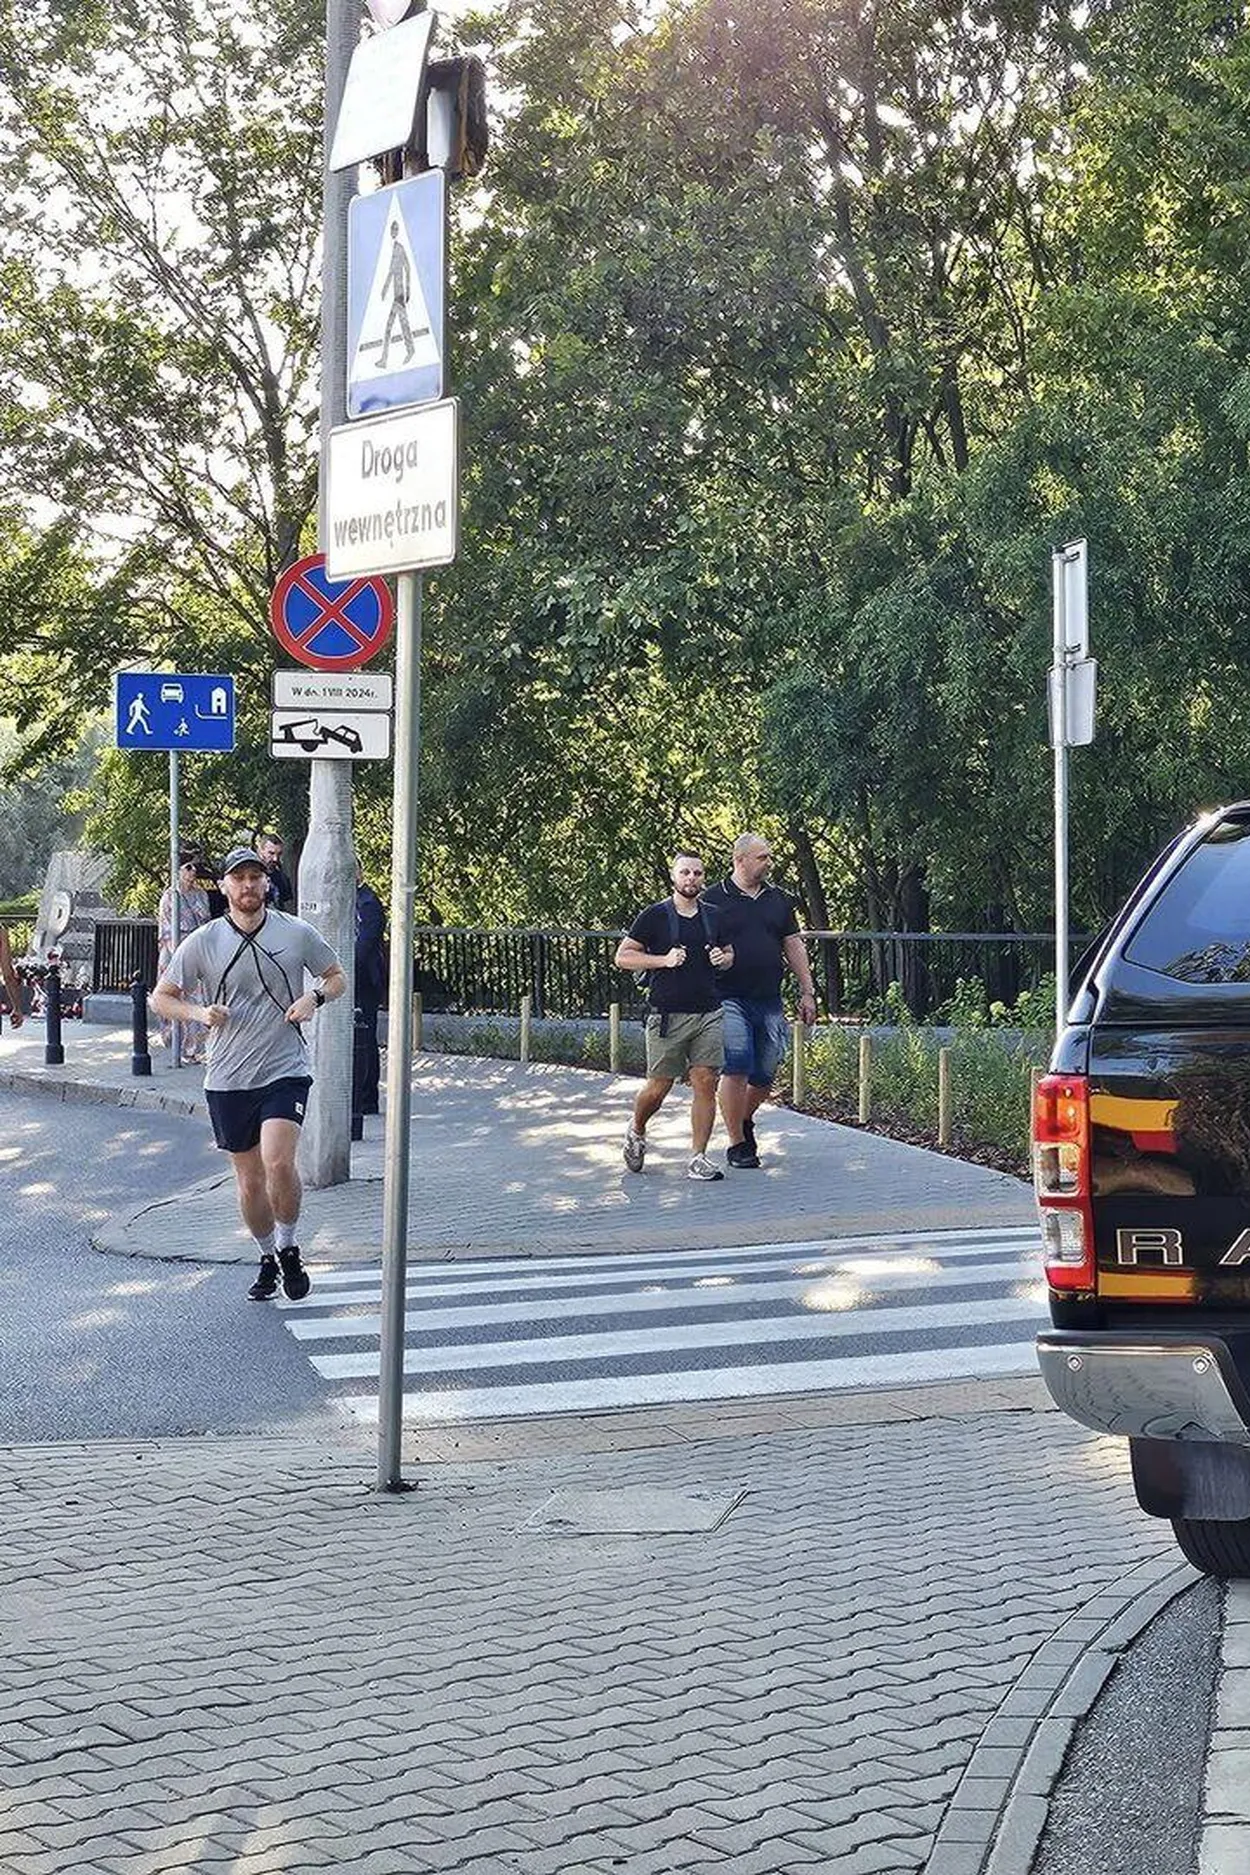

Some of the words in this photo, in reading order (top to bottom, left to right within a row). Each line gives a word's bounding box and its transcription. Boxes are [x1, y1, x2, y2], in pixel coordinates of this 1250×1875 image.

[361, 439, 418, 483] Droga
[334, 498, 446, 549] wewnętrzna
[291, 686, 303, 697] W
